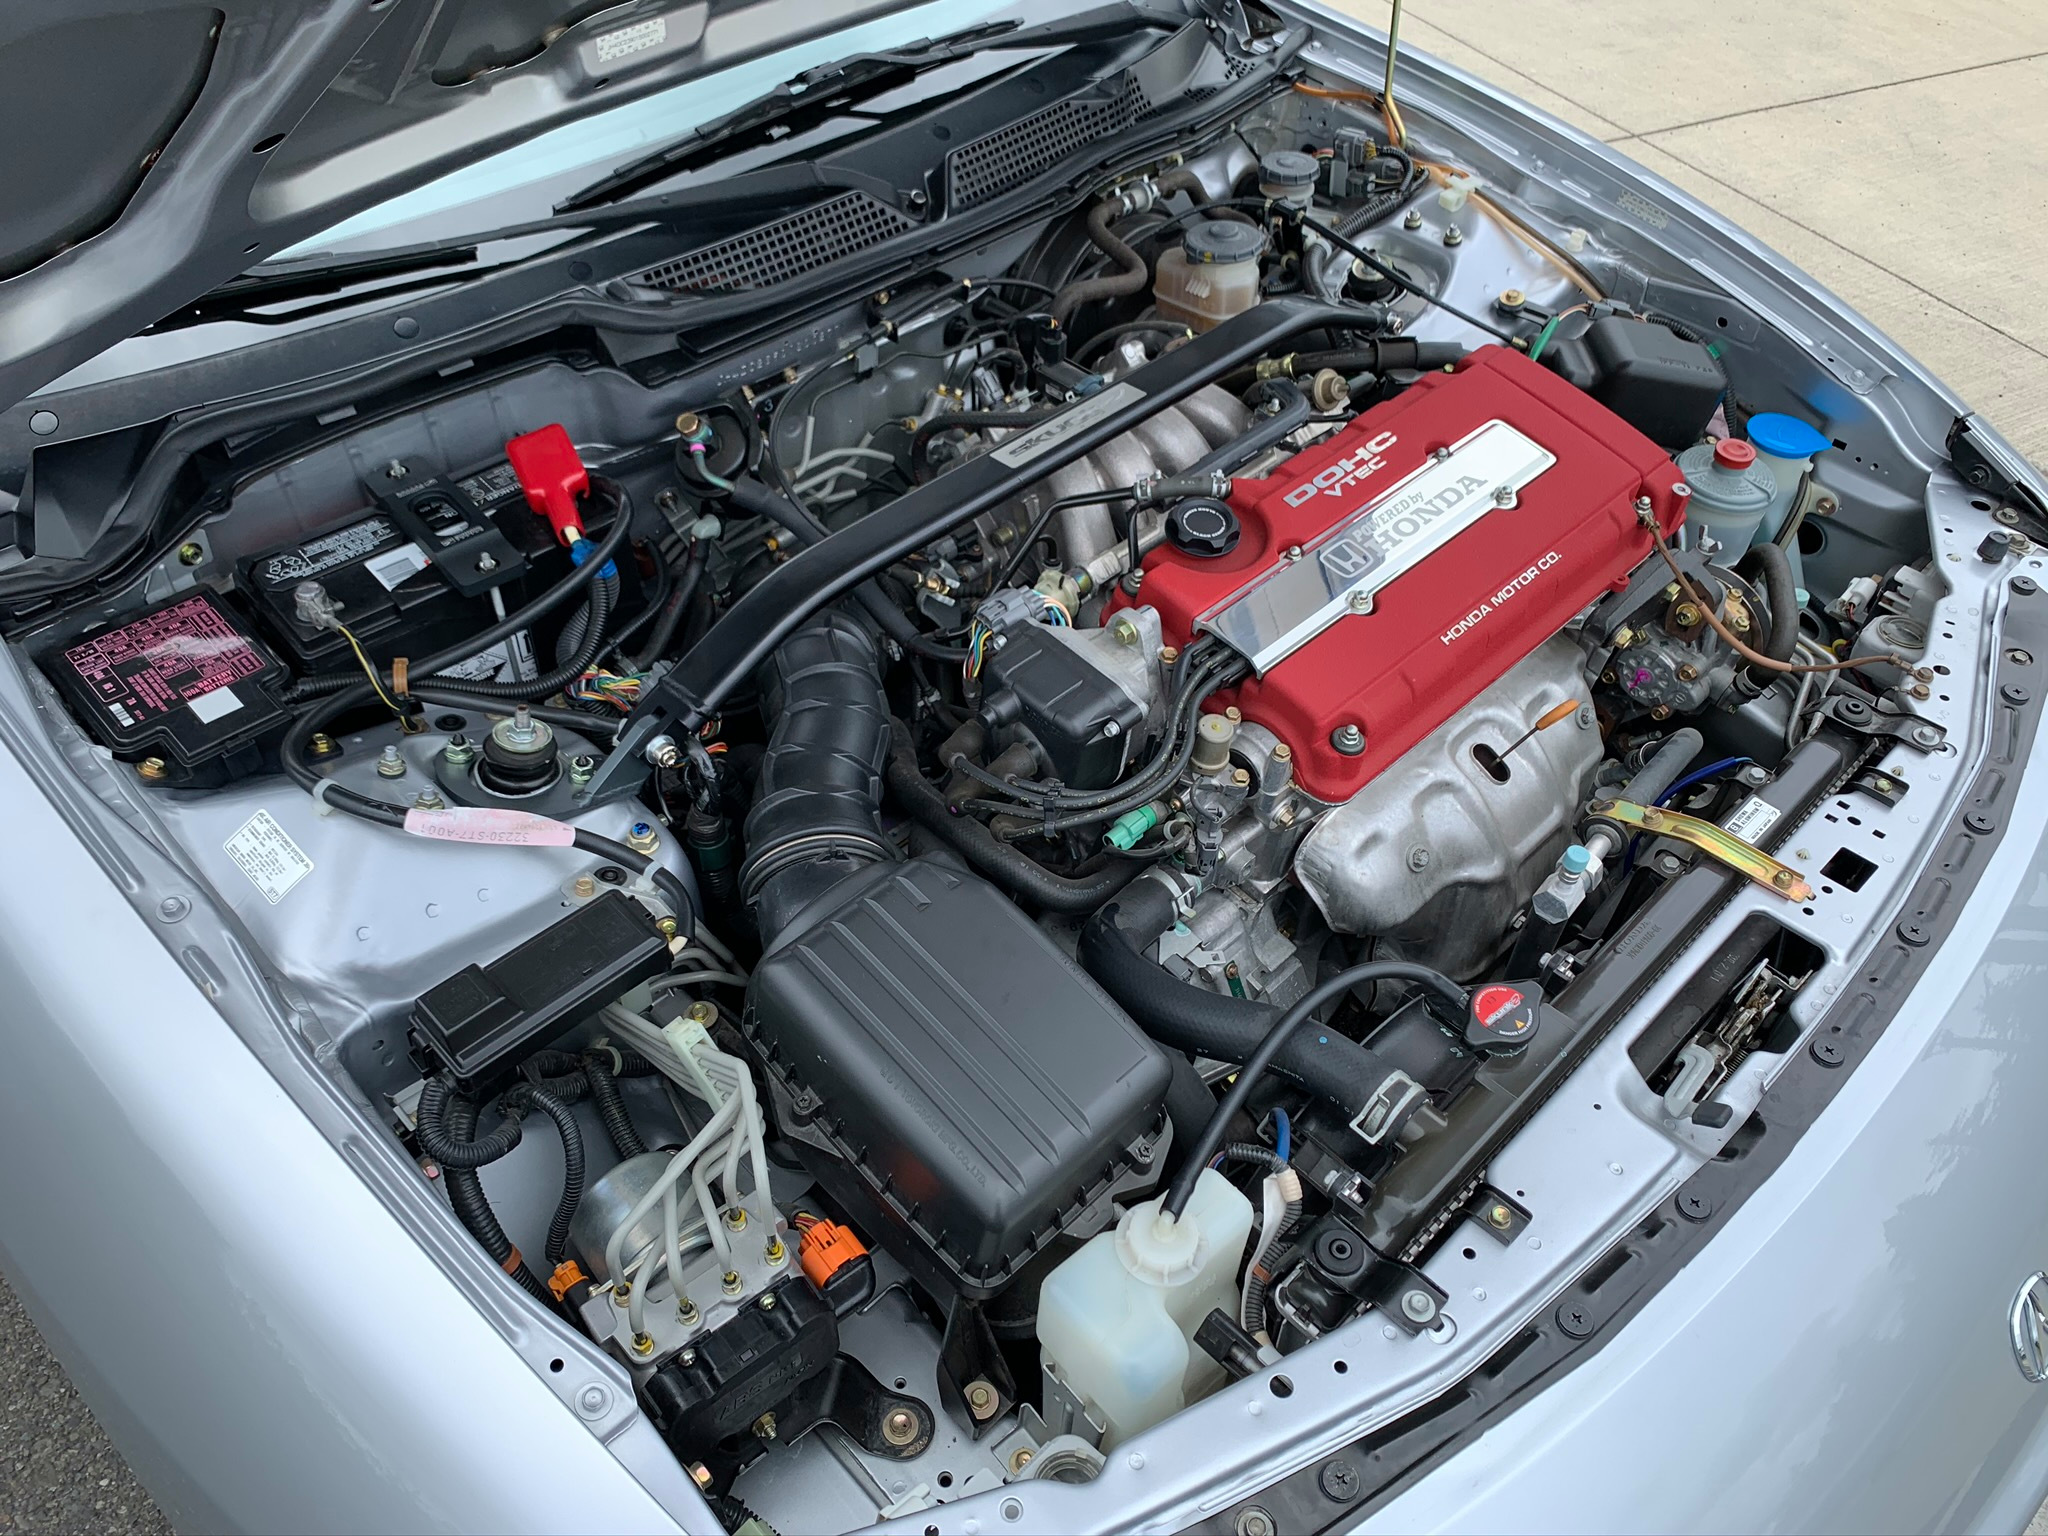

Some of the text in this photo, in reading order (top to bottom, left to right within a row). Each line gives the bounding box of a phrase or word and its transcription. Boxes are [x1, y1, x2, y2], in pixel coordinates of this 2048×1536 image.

[1283, 431, 1397, 508] DOHC
[1323, 456, 1387, 496] VTEC
[1352, 490, 1424, 542] POWERED by
[1362, 475, 1489, 557] HONDA
[1440, 551, 1562, 645] HONDA MOTOR CO.
[114, 645, 128, 654] 40A
[164, 659, 177, 668] 40A
[183, 687, 200, 698] 100A
[197, 670, 232, 688] BATTERY
[203, 676, 235, 693] BATTERIE
[270, 823, 292, 849] CONDITIONER
[290, 847, 306, 863] SYSTEM
[267, 887, 279, 899] ST7
